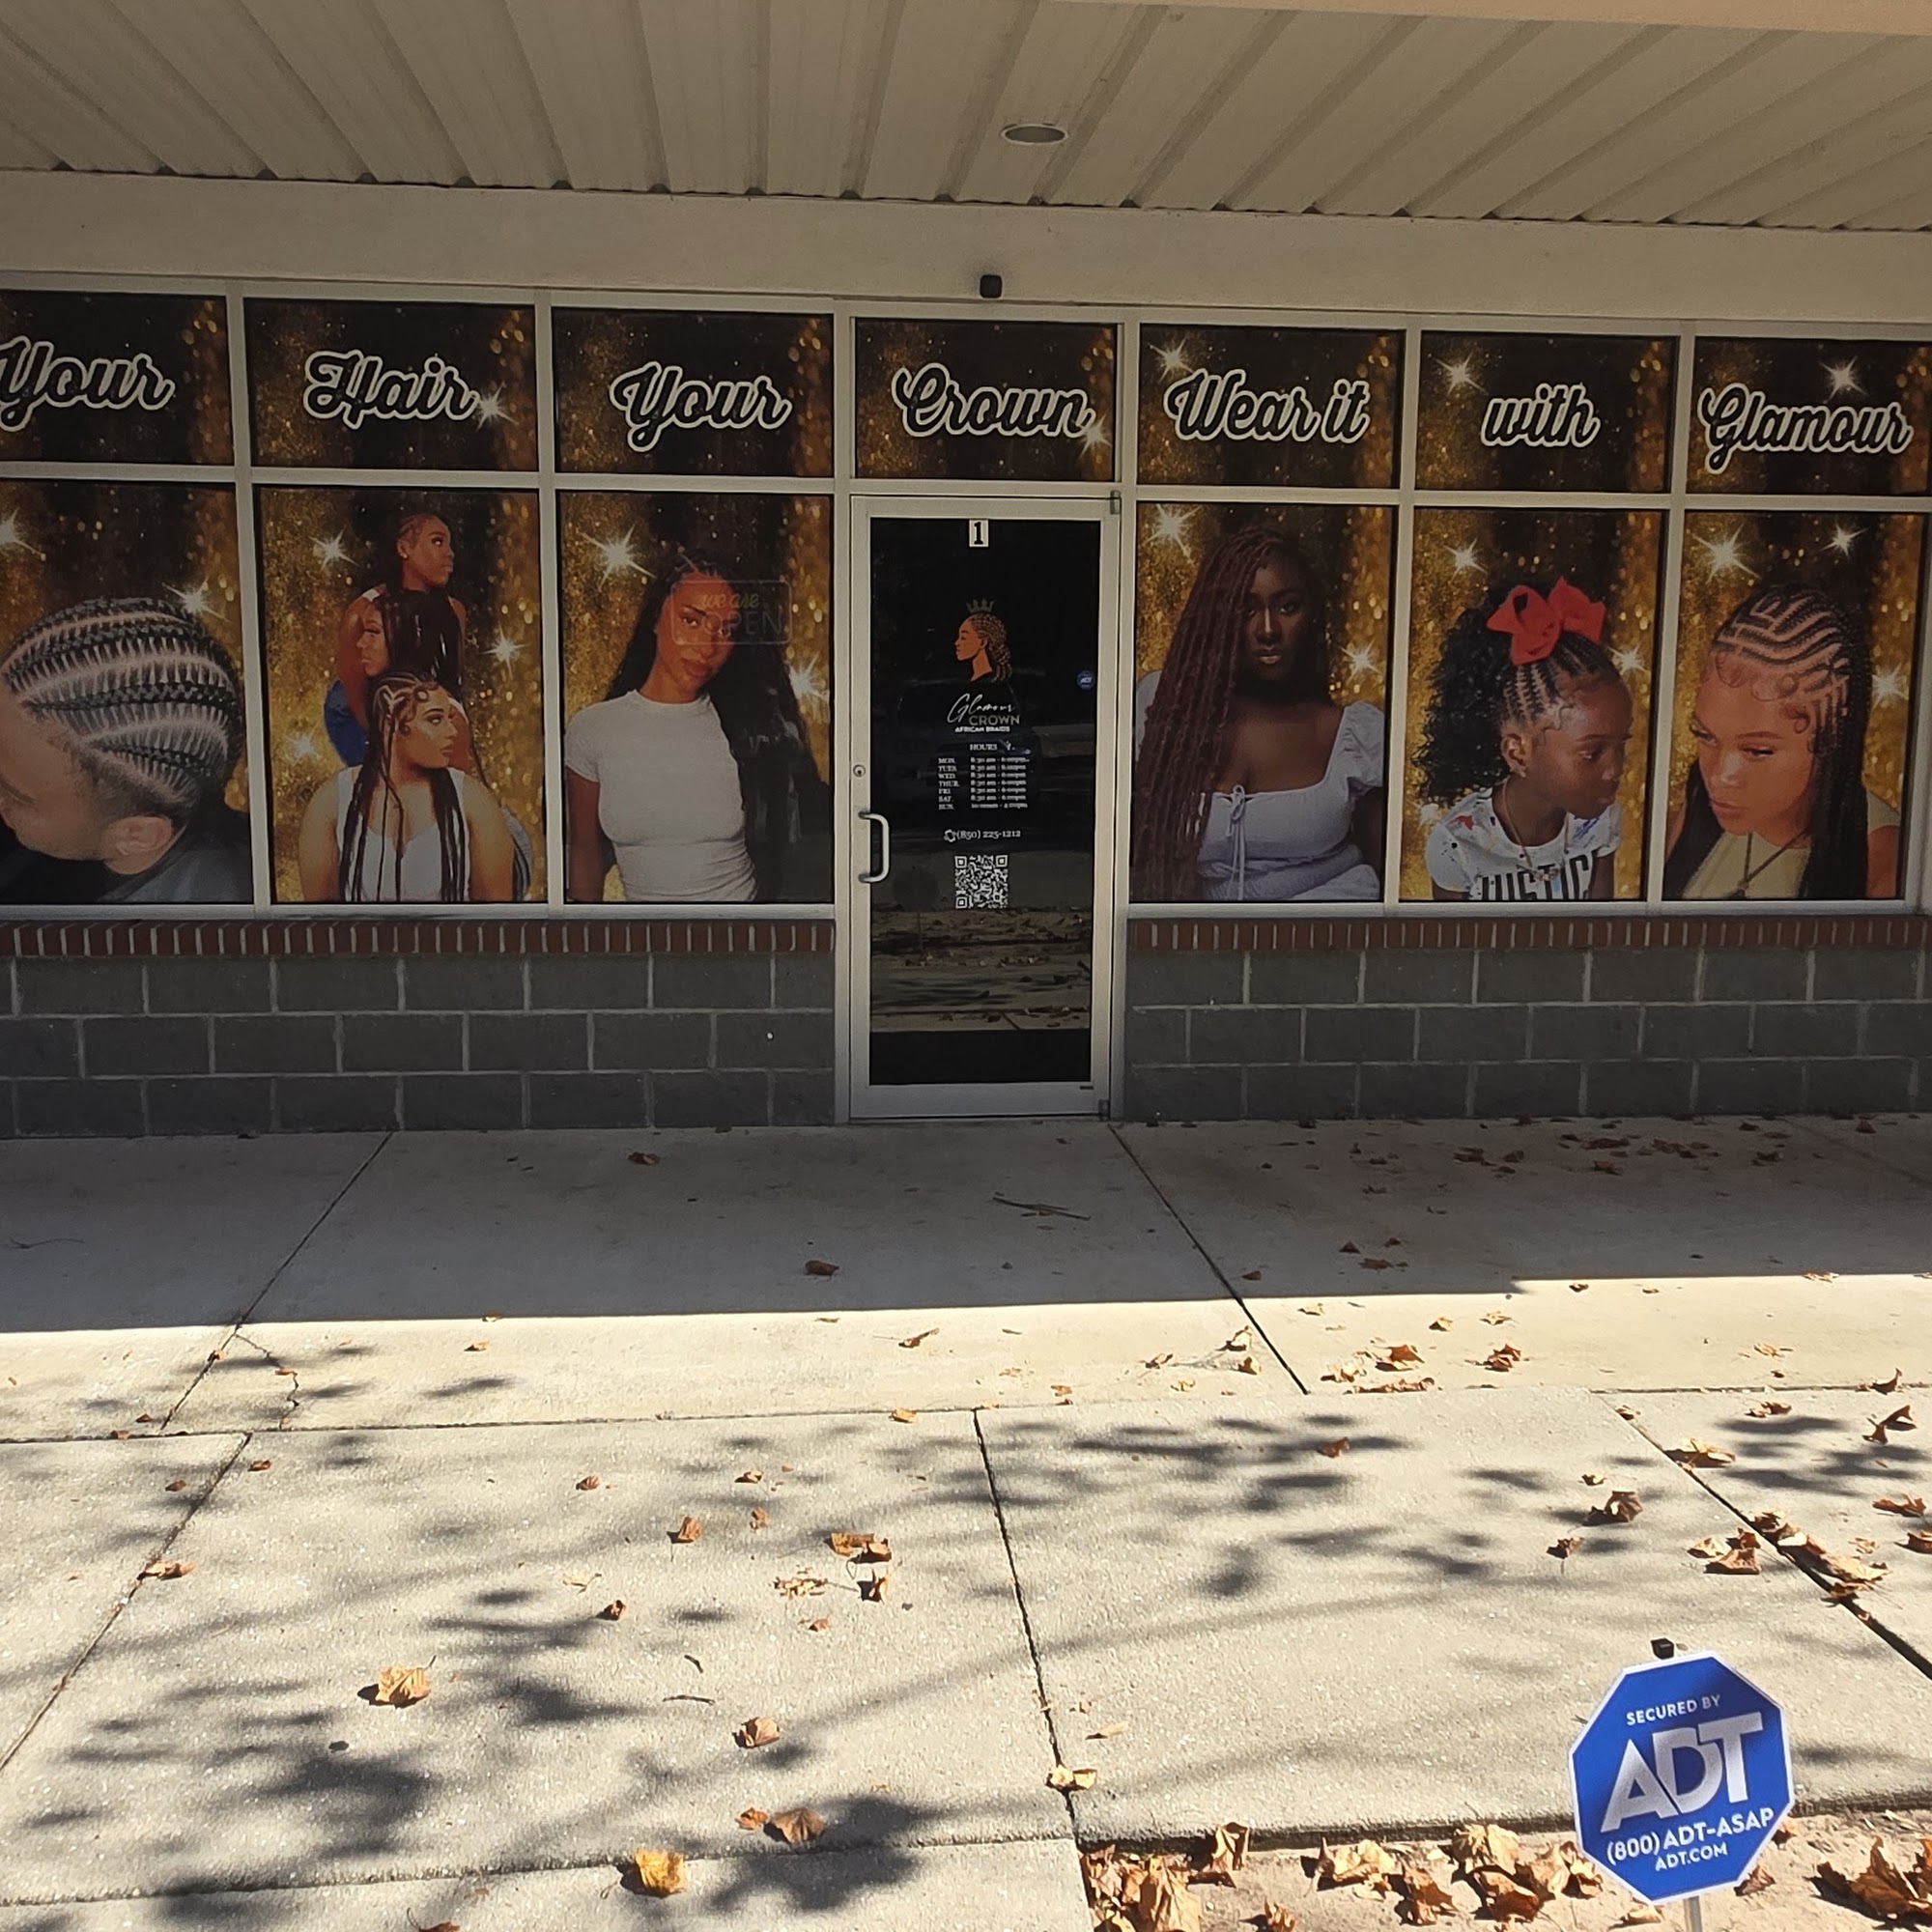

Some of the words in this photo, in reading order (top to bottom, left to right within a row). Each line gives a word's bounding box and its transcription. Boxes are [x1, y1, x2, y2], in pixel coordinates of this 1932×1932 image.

[0, 336, 175, 432] Your
[303, 349, 481, 429] Hair
[609, 360, 790, 451] Your
[891, 361, 1095, 437] Crown
[1163, 368, 1321, 441] Wear
[1321, 379, 1370, 443] it
[1480, 382, 1600, 446] with
[1697, 383, 1914, 474] Glamour
[974, 521, 983, 545] 1
[702, 609, 783, 638] OPEN
[969, 715, 1020, 725] CROWN
[956, 830, 980, 840] (850)
[982, 830, 1021, 839] 225-1212
[1626, 1699, 1697, 1726] SECURED
[1700, 1694, 1721, 1710] BY
[1600, 1711, 1764, 1833] ADT
[1606, 1832, 1661, 1866] (800)
[1662, 1806, 1776, 1850] ADT-ASAP
[1654, 1841, 1729, 1871] ADT.COM
